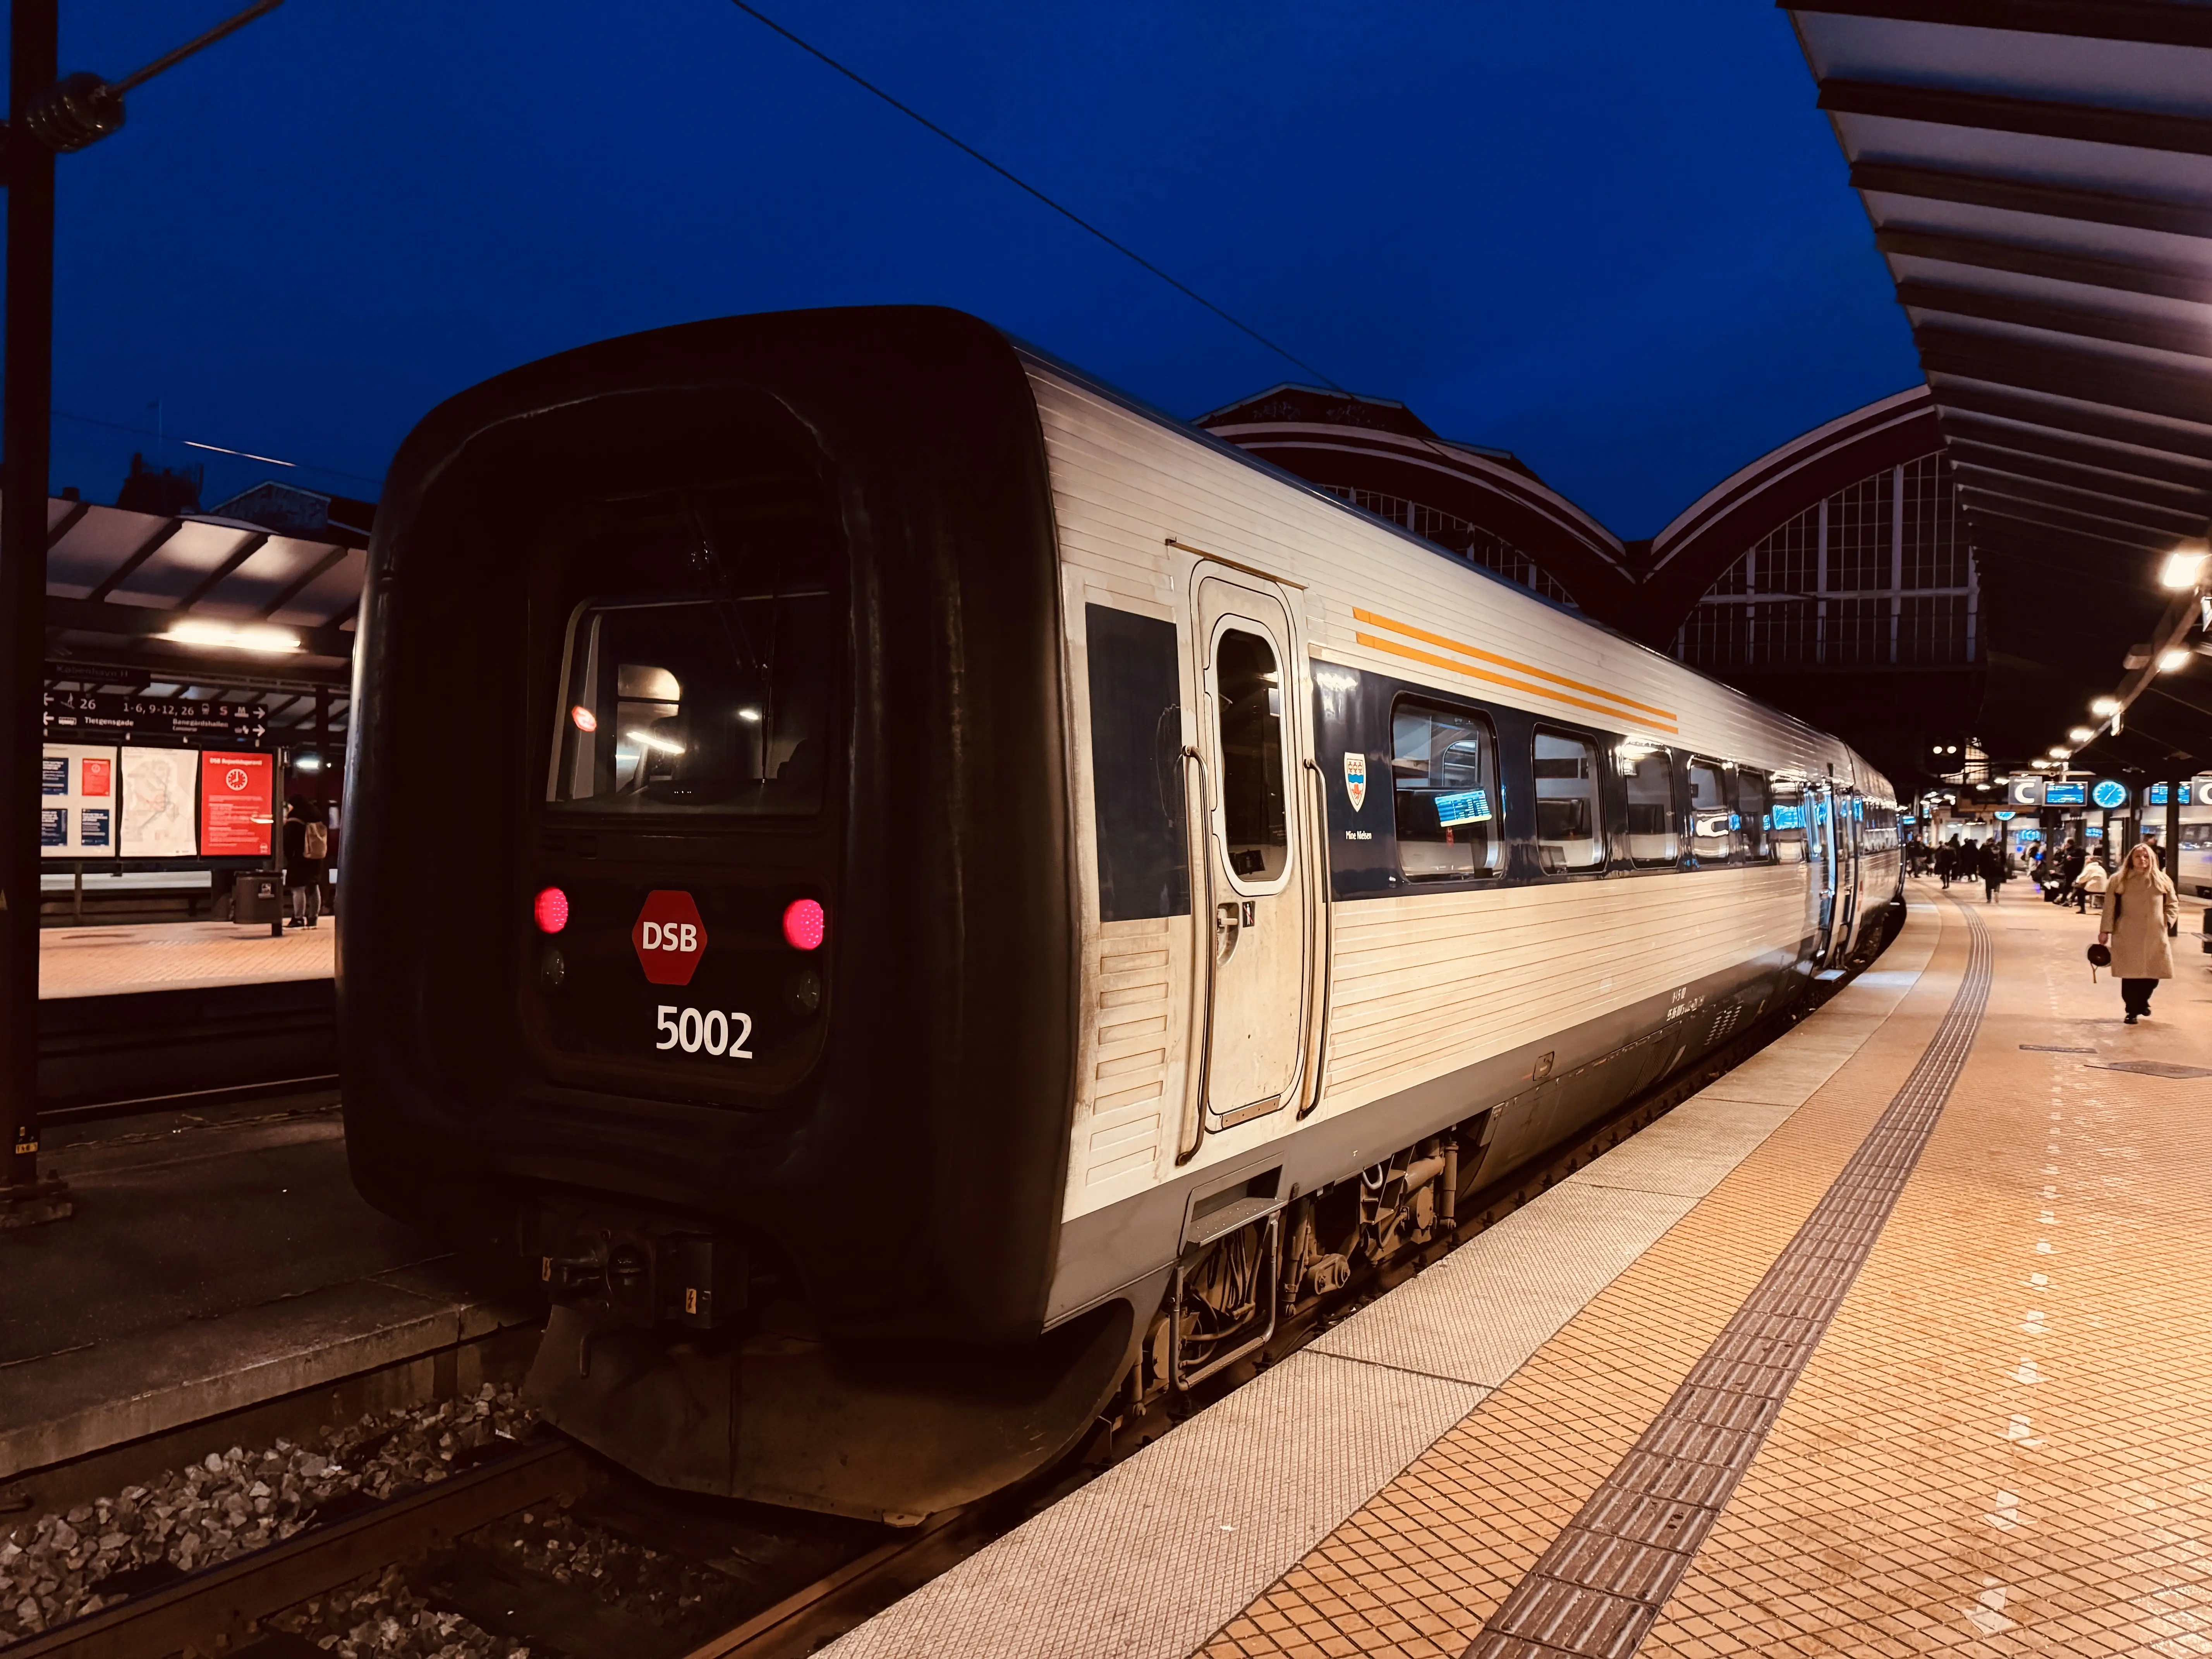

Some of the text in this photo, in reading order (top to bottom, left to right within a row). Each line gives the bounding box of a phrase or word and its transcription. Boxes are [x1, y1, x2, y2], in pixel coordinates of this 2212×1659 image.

[80, 698, 96, 709] 26
[181, 707, 194, 716] 26
[2015, 782, 2035, 804] C
[643, 922, 697, 952] DSB
[656, 1005, 752, 1059] 5002
